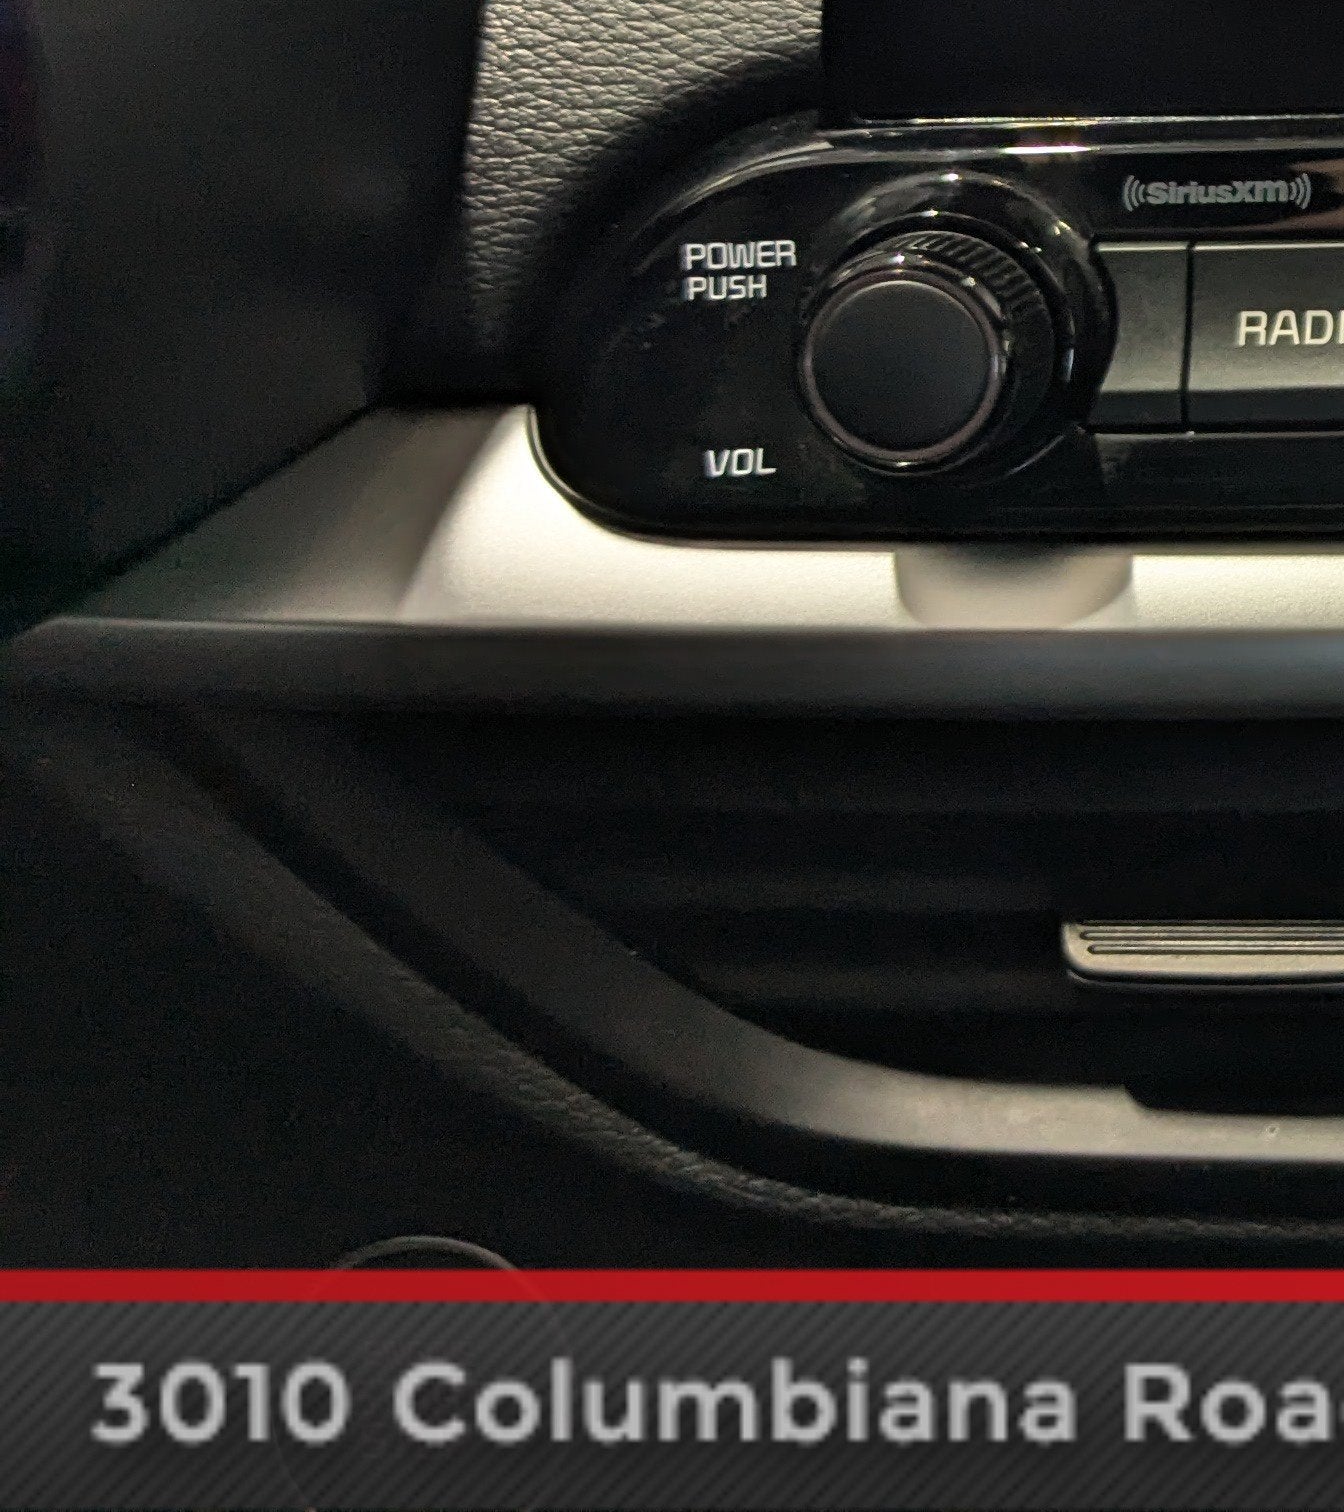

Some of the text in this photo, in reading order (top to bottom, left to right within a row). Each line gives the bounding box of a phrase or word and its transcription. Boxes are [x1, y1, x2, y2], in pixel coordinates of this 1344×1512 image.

[684, 240, 797, 270] POWER
[687, 274, 768, 302] PUSH
[704, 449, 776, 477] VOL
